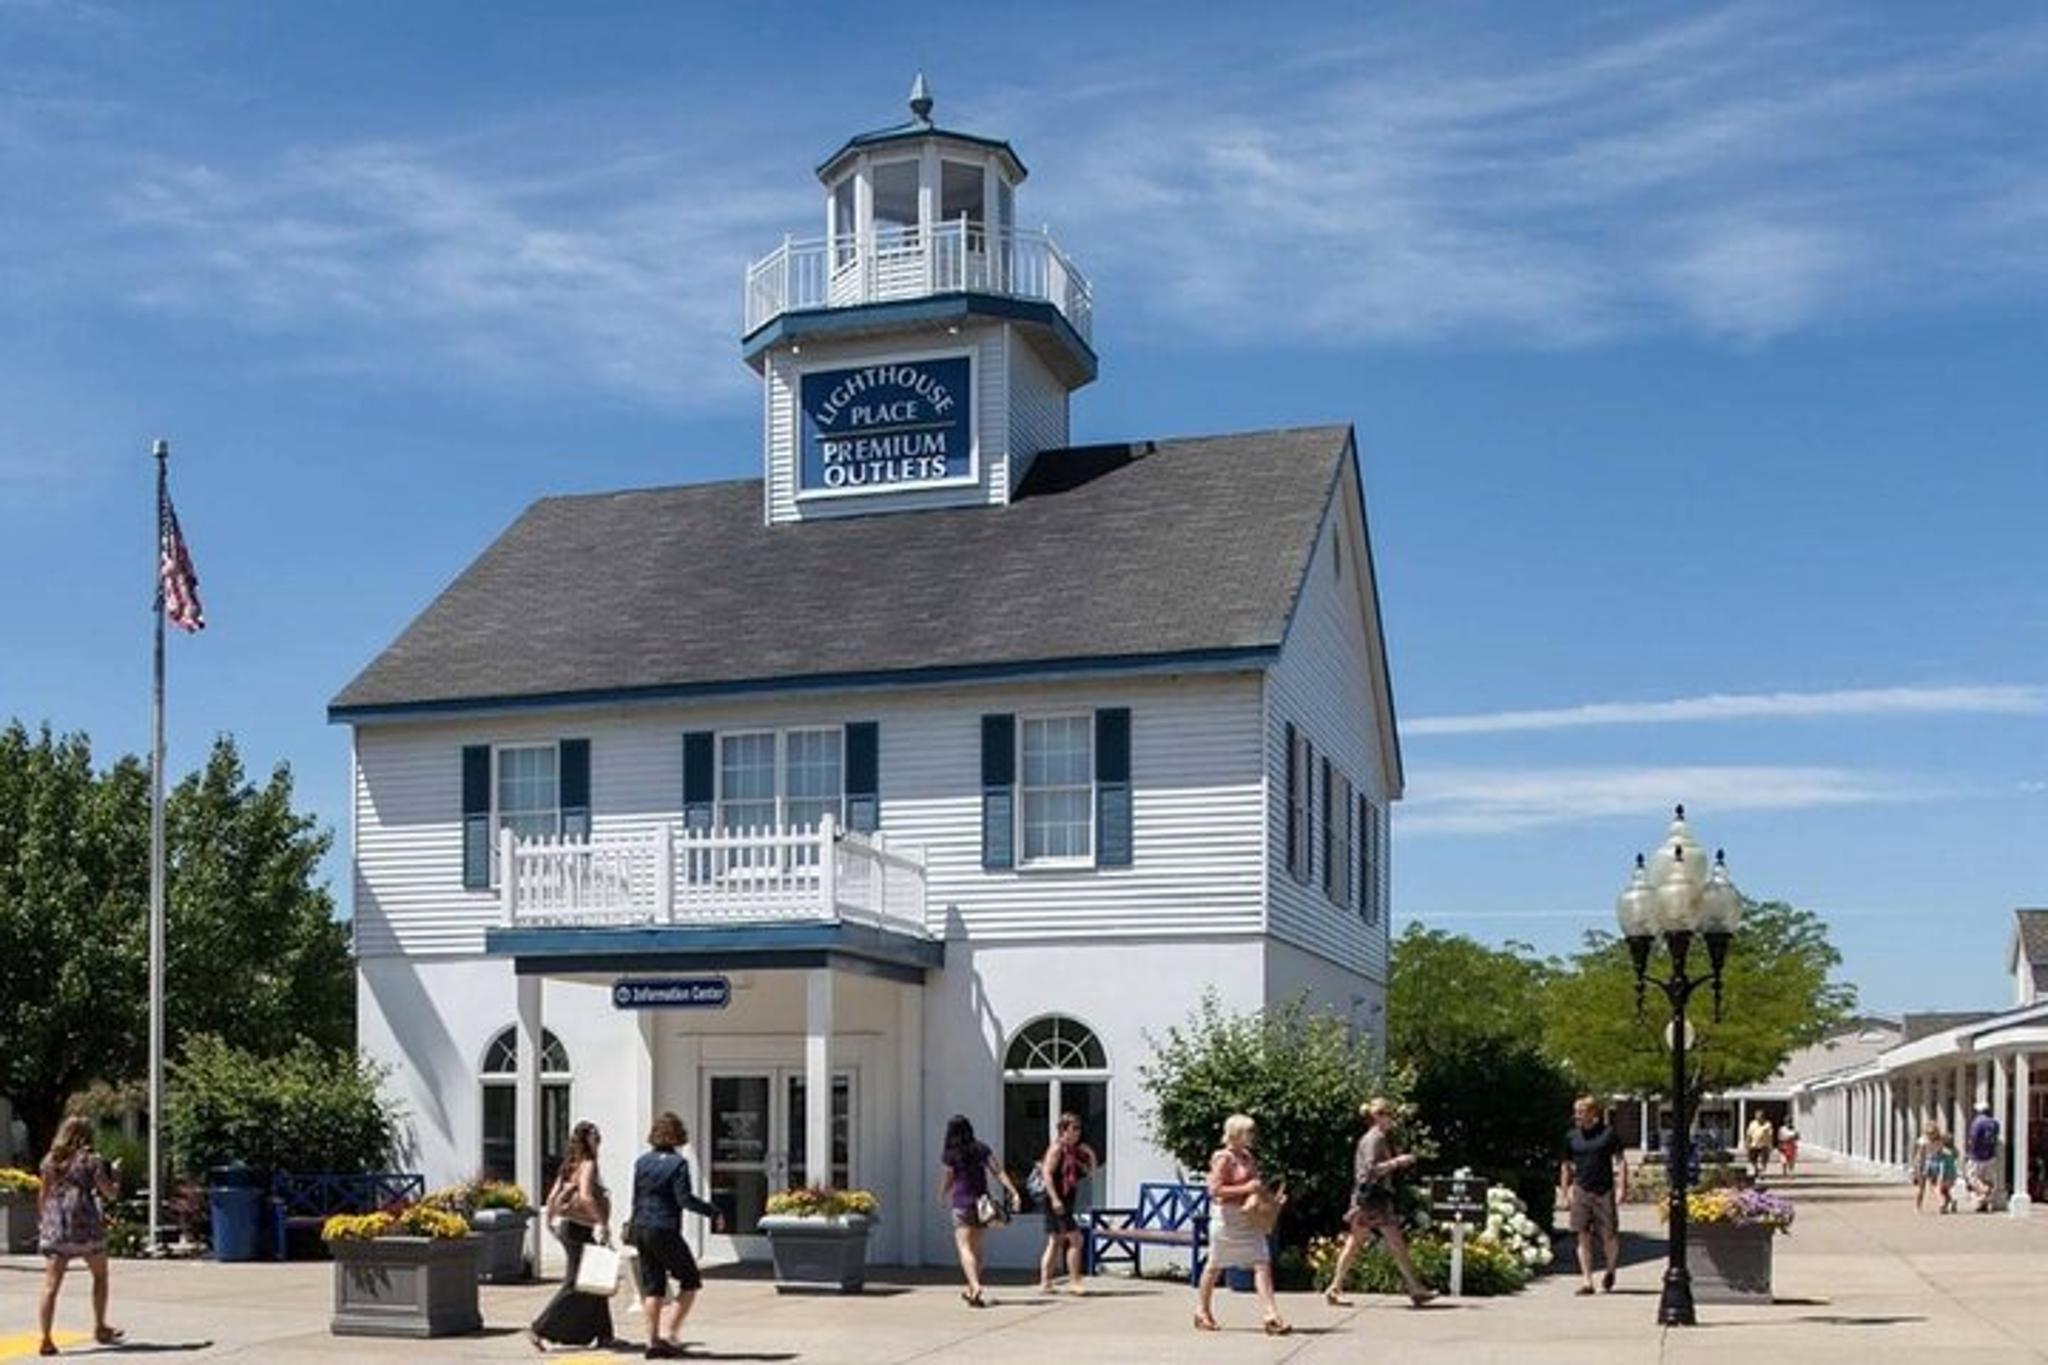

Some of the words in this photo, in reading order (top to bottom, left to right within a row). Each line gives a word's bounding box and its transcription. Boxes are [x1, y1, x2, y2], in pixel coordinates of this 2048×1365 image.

[817, 365, 955, 426] LIGHTHOUSE
[851, 401, 919, 425] PLACE
[823, 433, 947, 464] PREMIUM
[823, 455, 947, 488] OUTLETS
[633, 986, 689, 1002] Information
